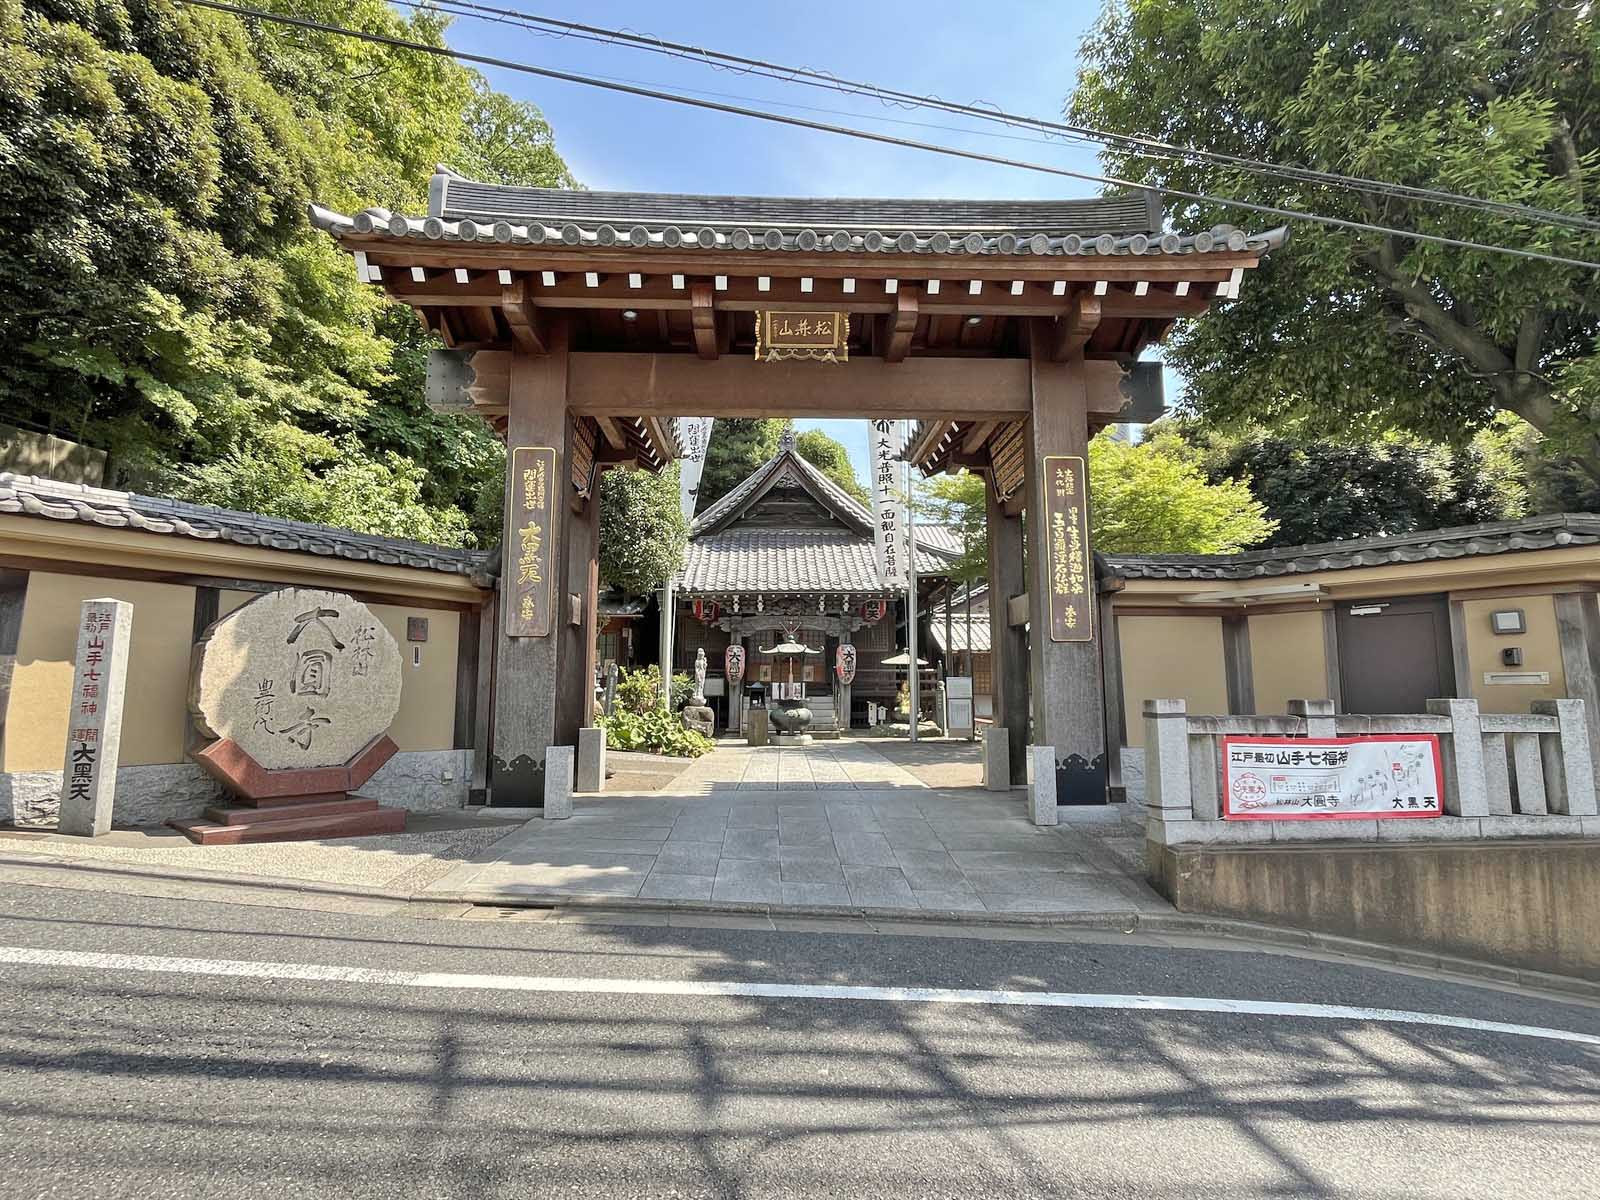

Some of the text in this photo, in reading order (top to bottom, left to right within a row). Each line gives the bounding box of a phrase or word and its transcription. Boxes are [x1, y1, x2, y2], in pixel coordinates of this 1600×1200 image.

[80, 635, 104, 716] 山手七福神
[279, 606, 346, 750] 大圓寺
